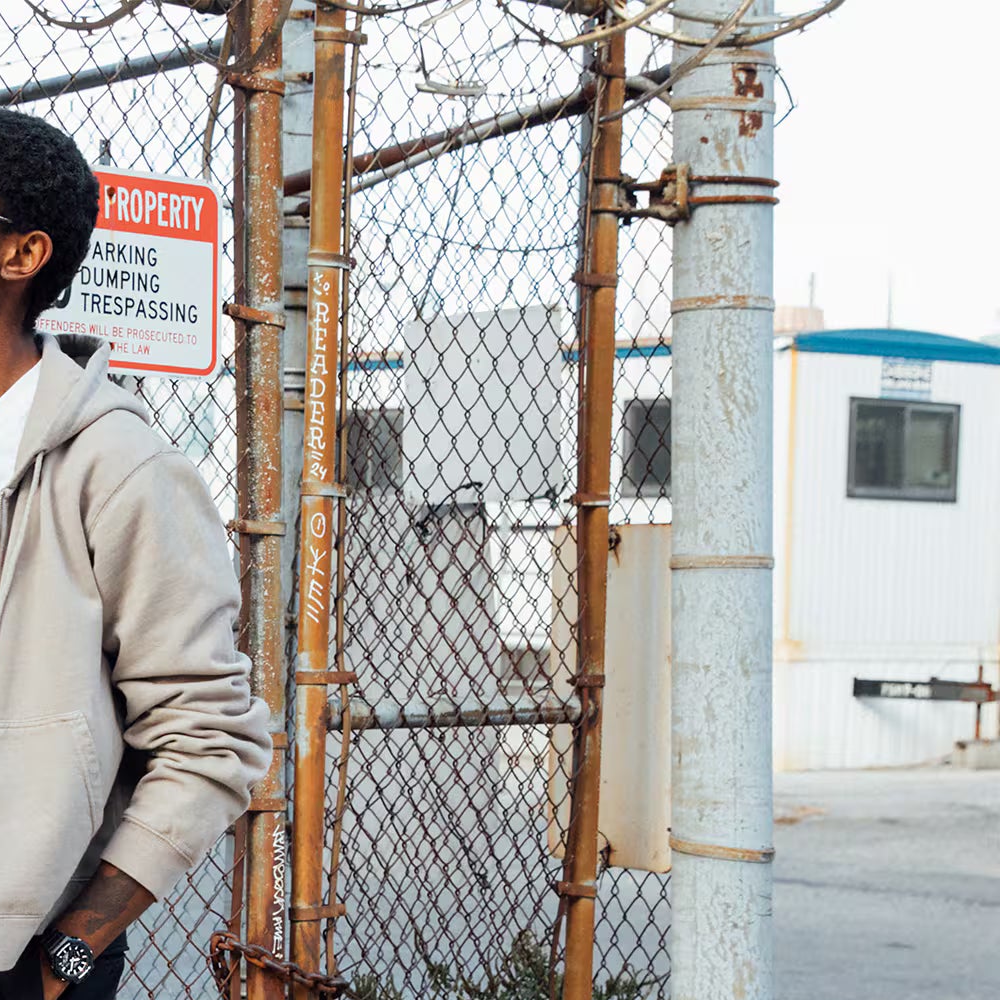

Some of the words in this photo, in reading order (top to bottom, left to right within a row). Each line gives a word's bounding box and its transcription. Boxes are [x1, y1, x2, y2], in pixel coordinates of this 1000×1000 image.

[103, 184, 205, 232] PROPERTY
[91, 241, 158, 267] ARKING
[80, 265, 160, 294] DUMPING
[80, 292, 198, 324] TRESPASSING
[89, 323, 109, 337] WILL
[112, 326, 123, 338] BE
[126, 328, 184, 344] PROSECUTED
[187, 333, 197, 345] TO
[131, 343, 151, 355] LAW
[308, 301, 331, 453] READER
